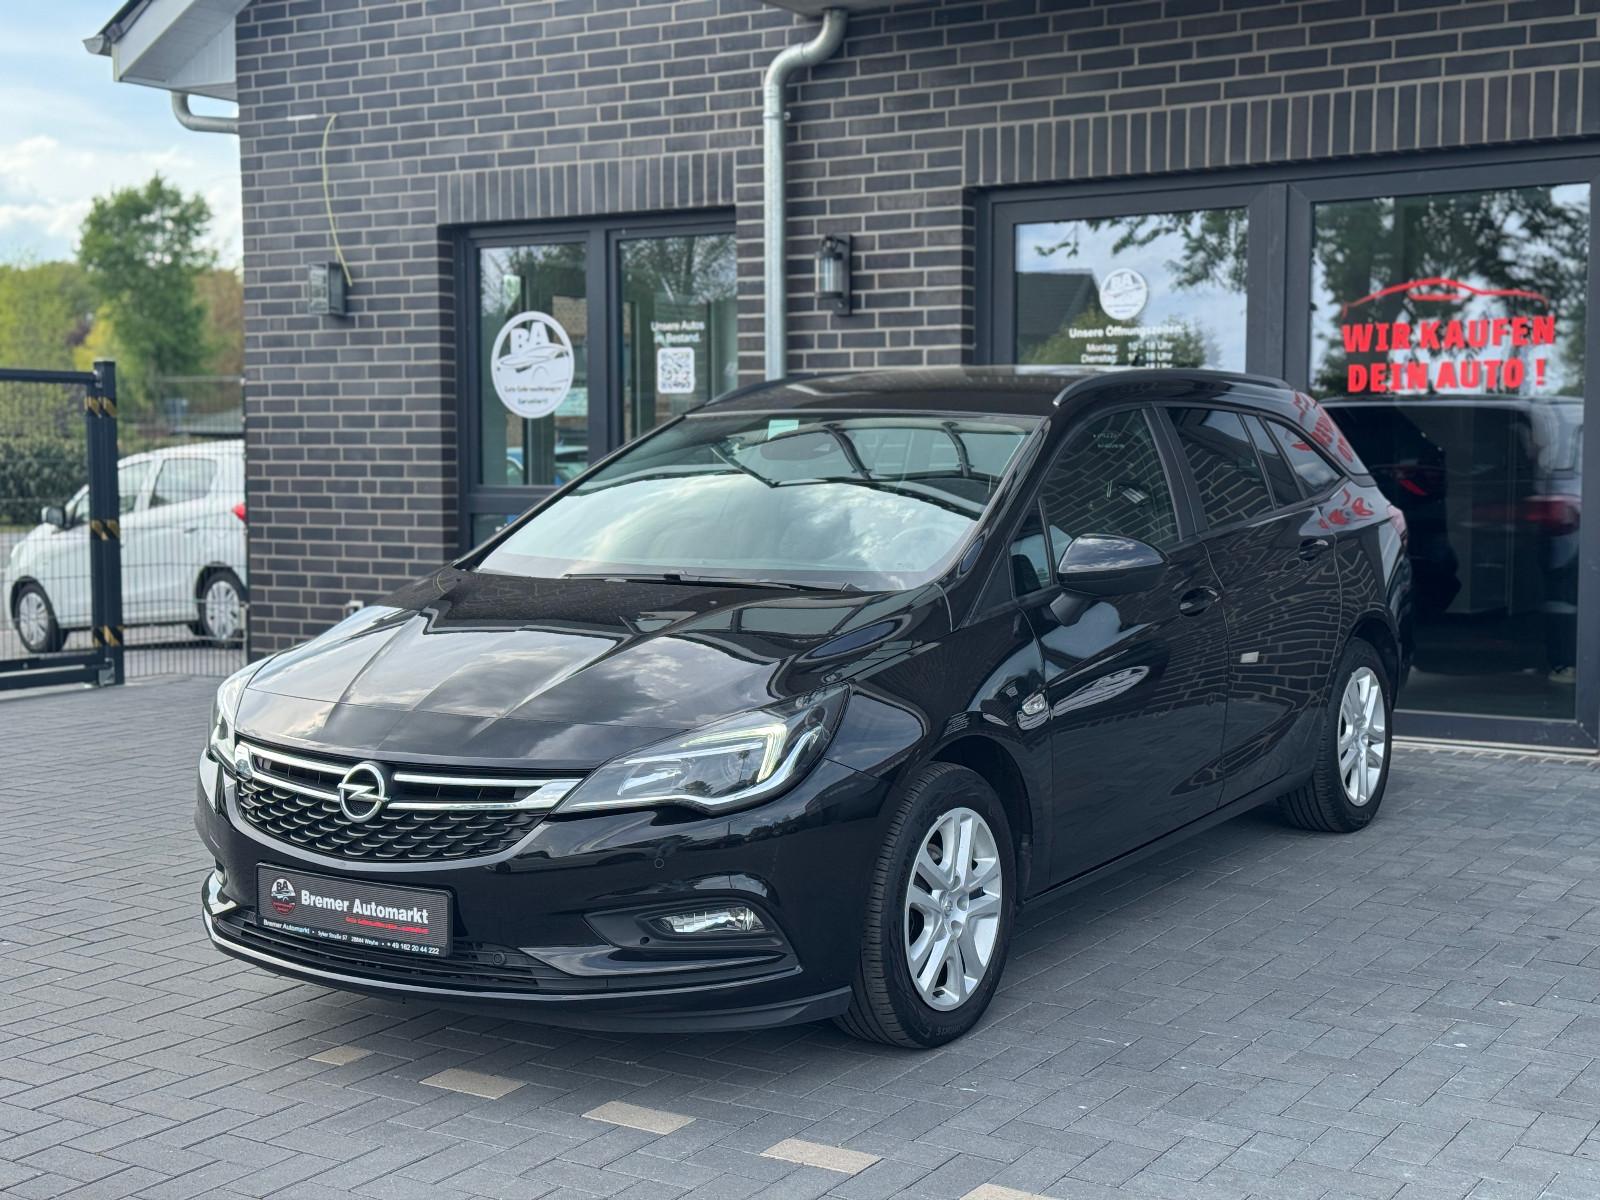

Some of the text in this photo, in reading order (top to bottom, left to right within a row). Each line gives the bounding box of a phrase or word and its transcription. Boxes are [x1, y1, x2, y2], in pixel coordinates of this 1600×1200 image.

[510, 321, 550, 356] BA
[1068, 328, 1104, 338] Unsere
[1157, 341, 1173, 351] Uhr
[1342, 315, 1555, 353] WIR KAUFEN
[1157, 351, 1173, 361] Uhr
[1347, 357, 1547, 393] DEIN AUTO !
[276, 880, 289, 891] BA
[301, 889, 350, 912] Bremer
[353, 898, 429, 924] Automarkt
[263, 919, 282, 929] Bremer
[282, 923, 310, 934] Automarkt
[411, 944, 419, 952] 20
[428, 947, 439, 955] 222
